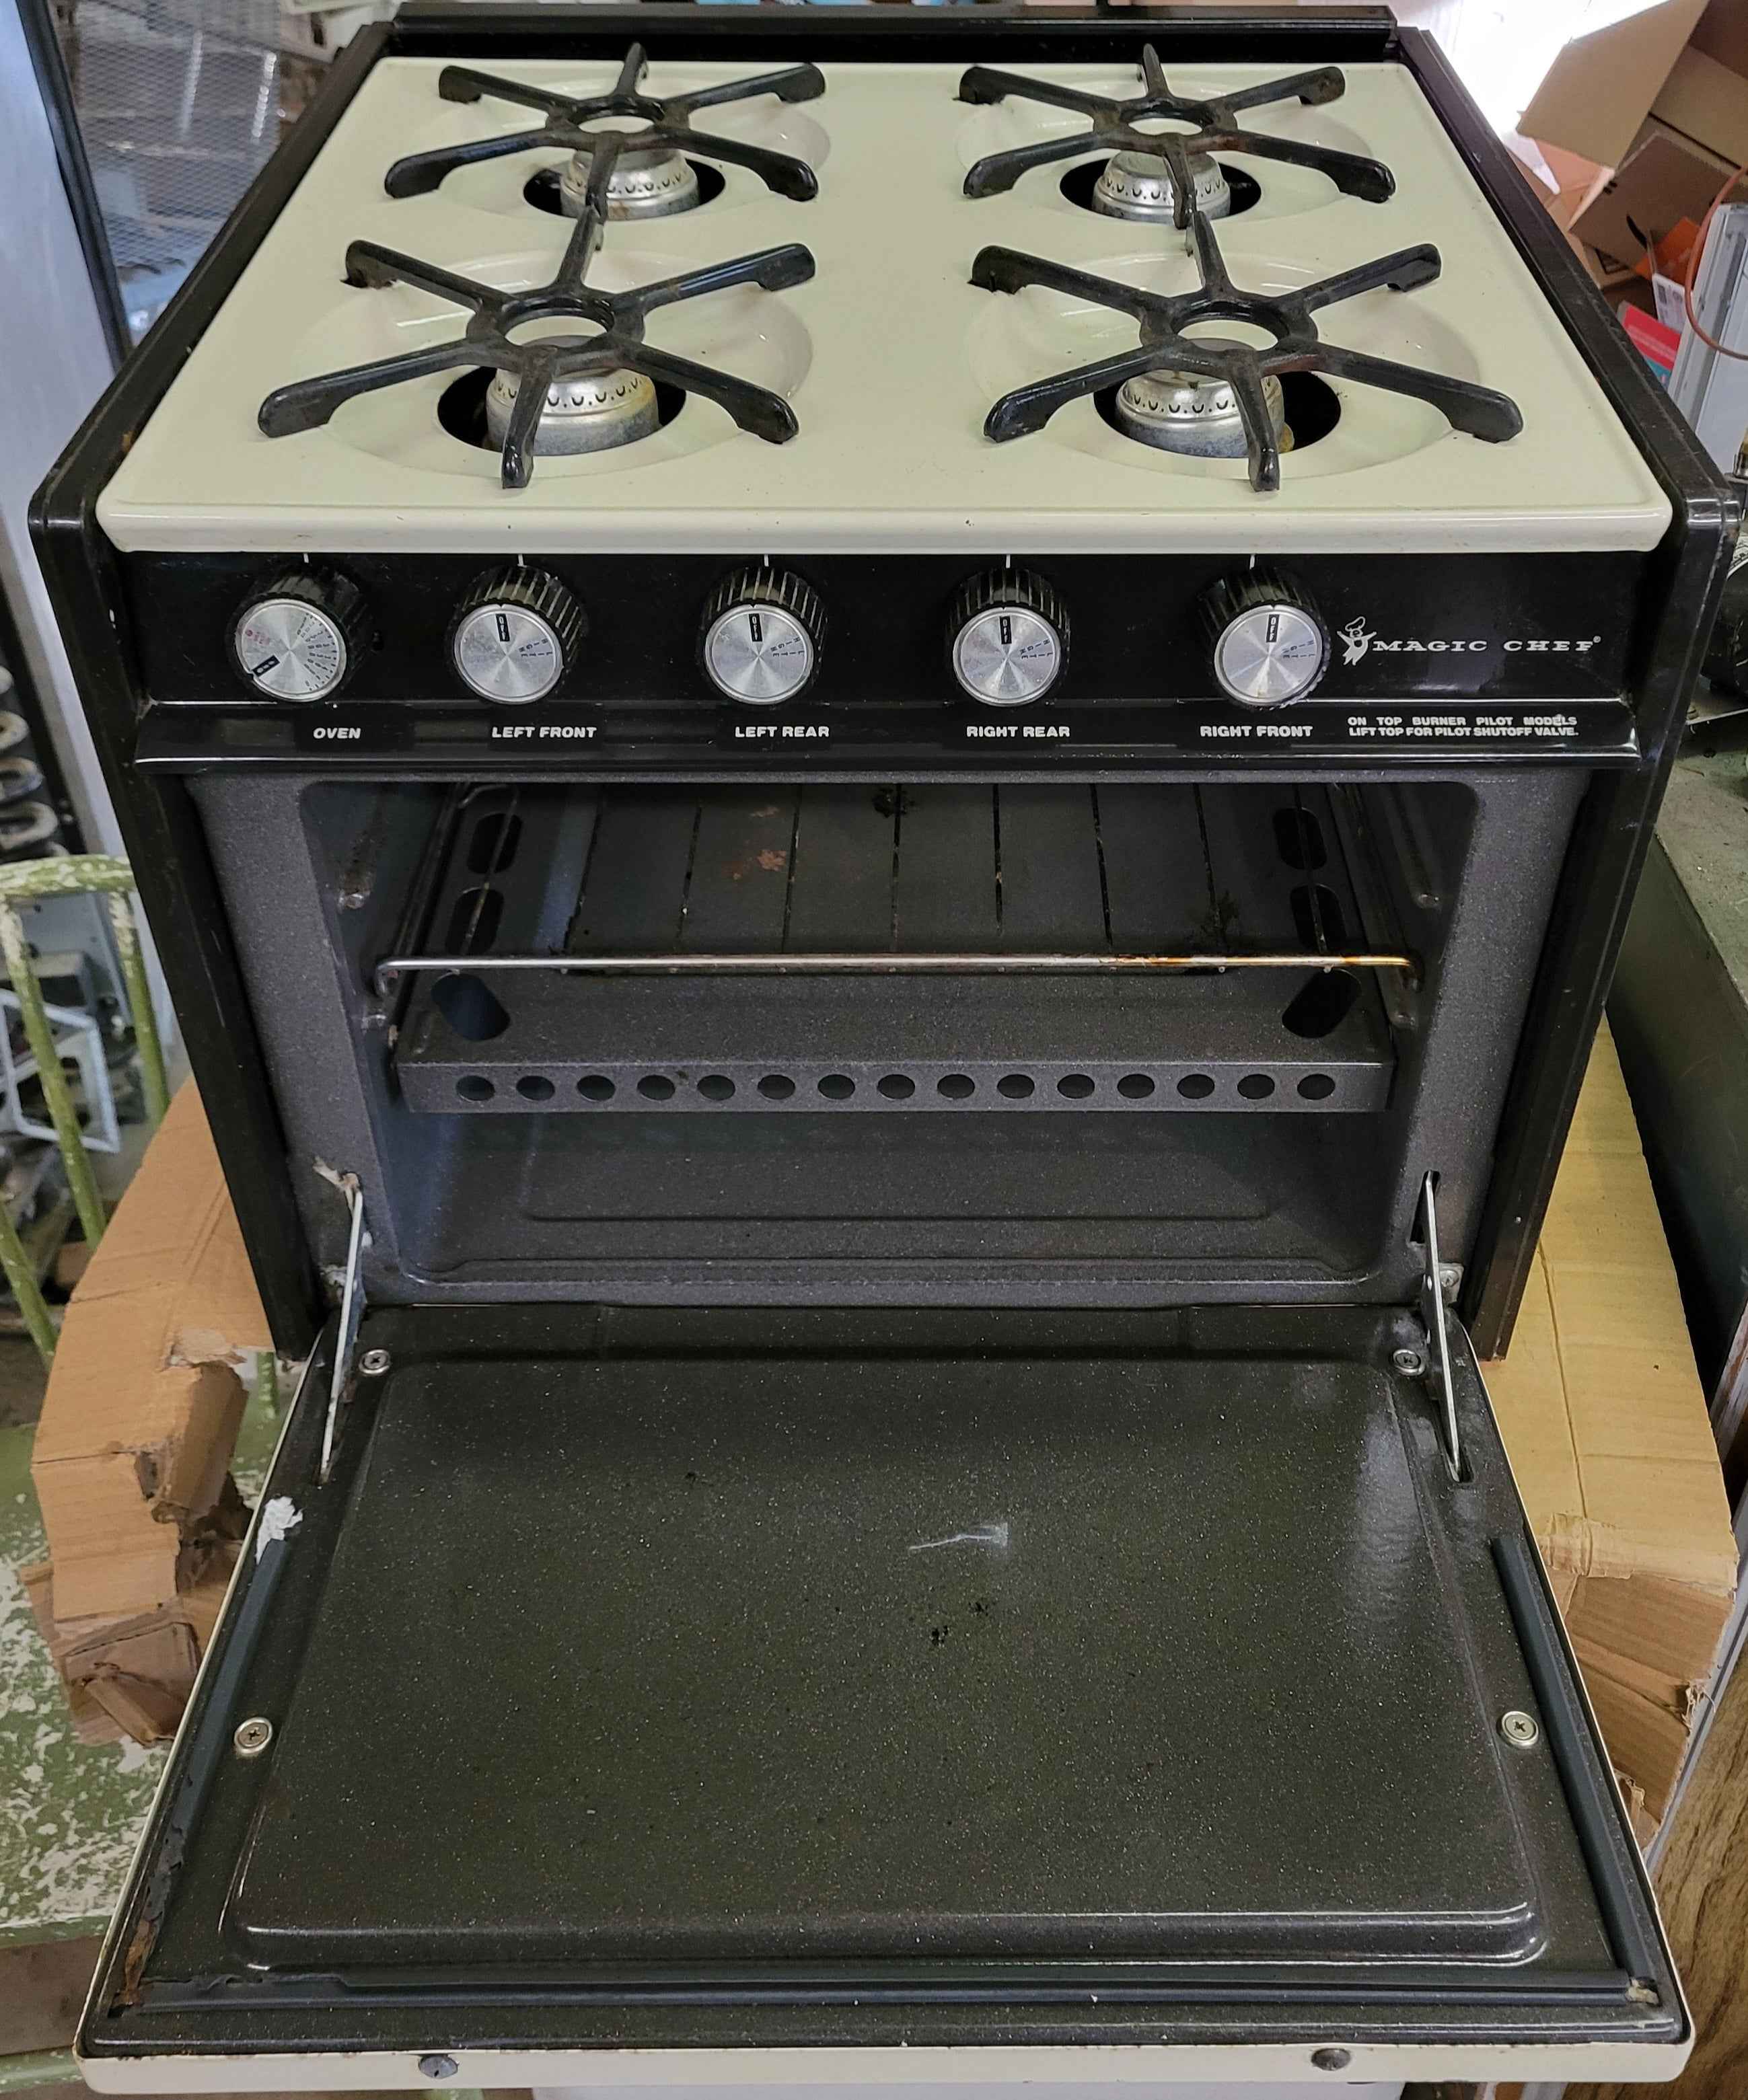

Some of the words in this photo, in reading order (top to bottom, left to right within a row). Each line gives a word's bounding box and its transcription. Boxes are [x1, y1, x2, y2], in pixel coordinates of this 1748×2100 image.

[1372, 640, 1488, 652] MAGIC
[1347, 716, 1367, 726] ON
[1376, 716, 1403, 726] TOP
[1412, 716, 1467, 726] BURNER
[1476, 716, 1514, 726] PILOT
[1523, 716, 1578, 726] MODELS
[313, 727, 361, 739] OVEN
[492, 726, 536, 738] LEFT
[539, 726, 597, 738] FRONT
[735, 726, 778, 738] LEFT
[782, 726, 830, 737] REAR
[966, 726, 1019, 737] RIGHT
[1023, 726, 1070, 738] REAR
[1200, 725, 1252, 737] RIGHT
[1256, 725, 1313, 737] FRONT
[1349, 727, 1377, 737] LIFT
[1378, 727, 1404, 737] TOP
[1406, 727, 1433, 737] FOR
[1434, 727, 1472, 737] PILOT
[1473, 727, 1533, 737] SHUTOFF
[1533, 727, 1579, 737] VALVE.
